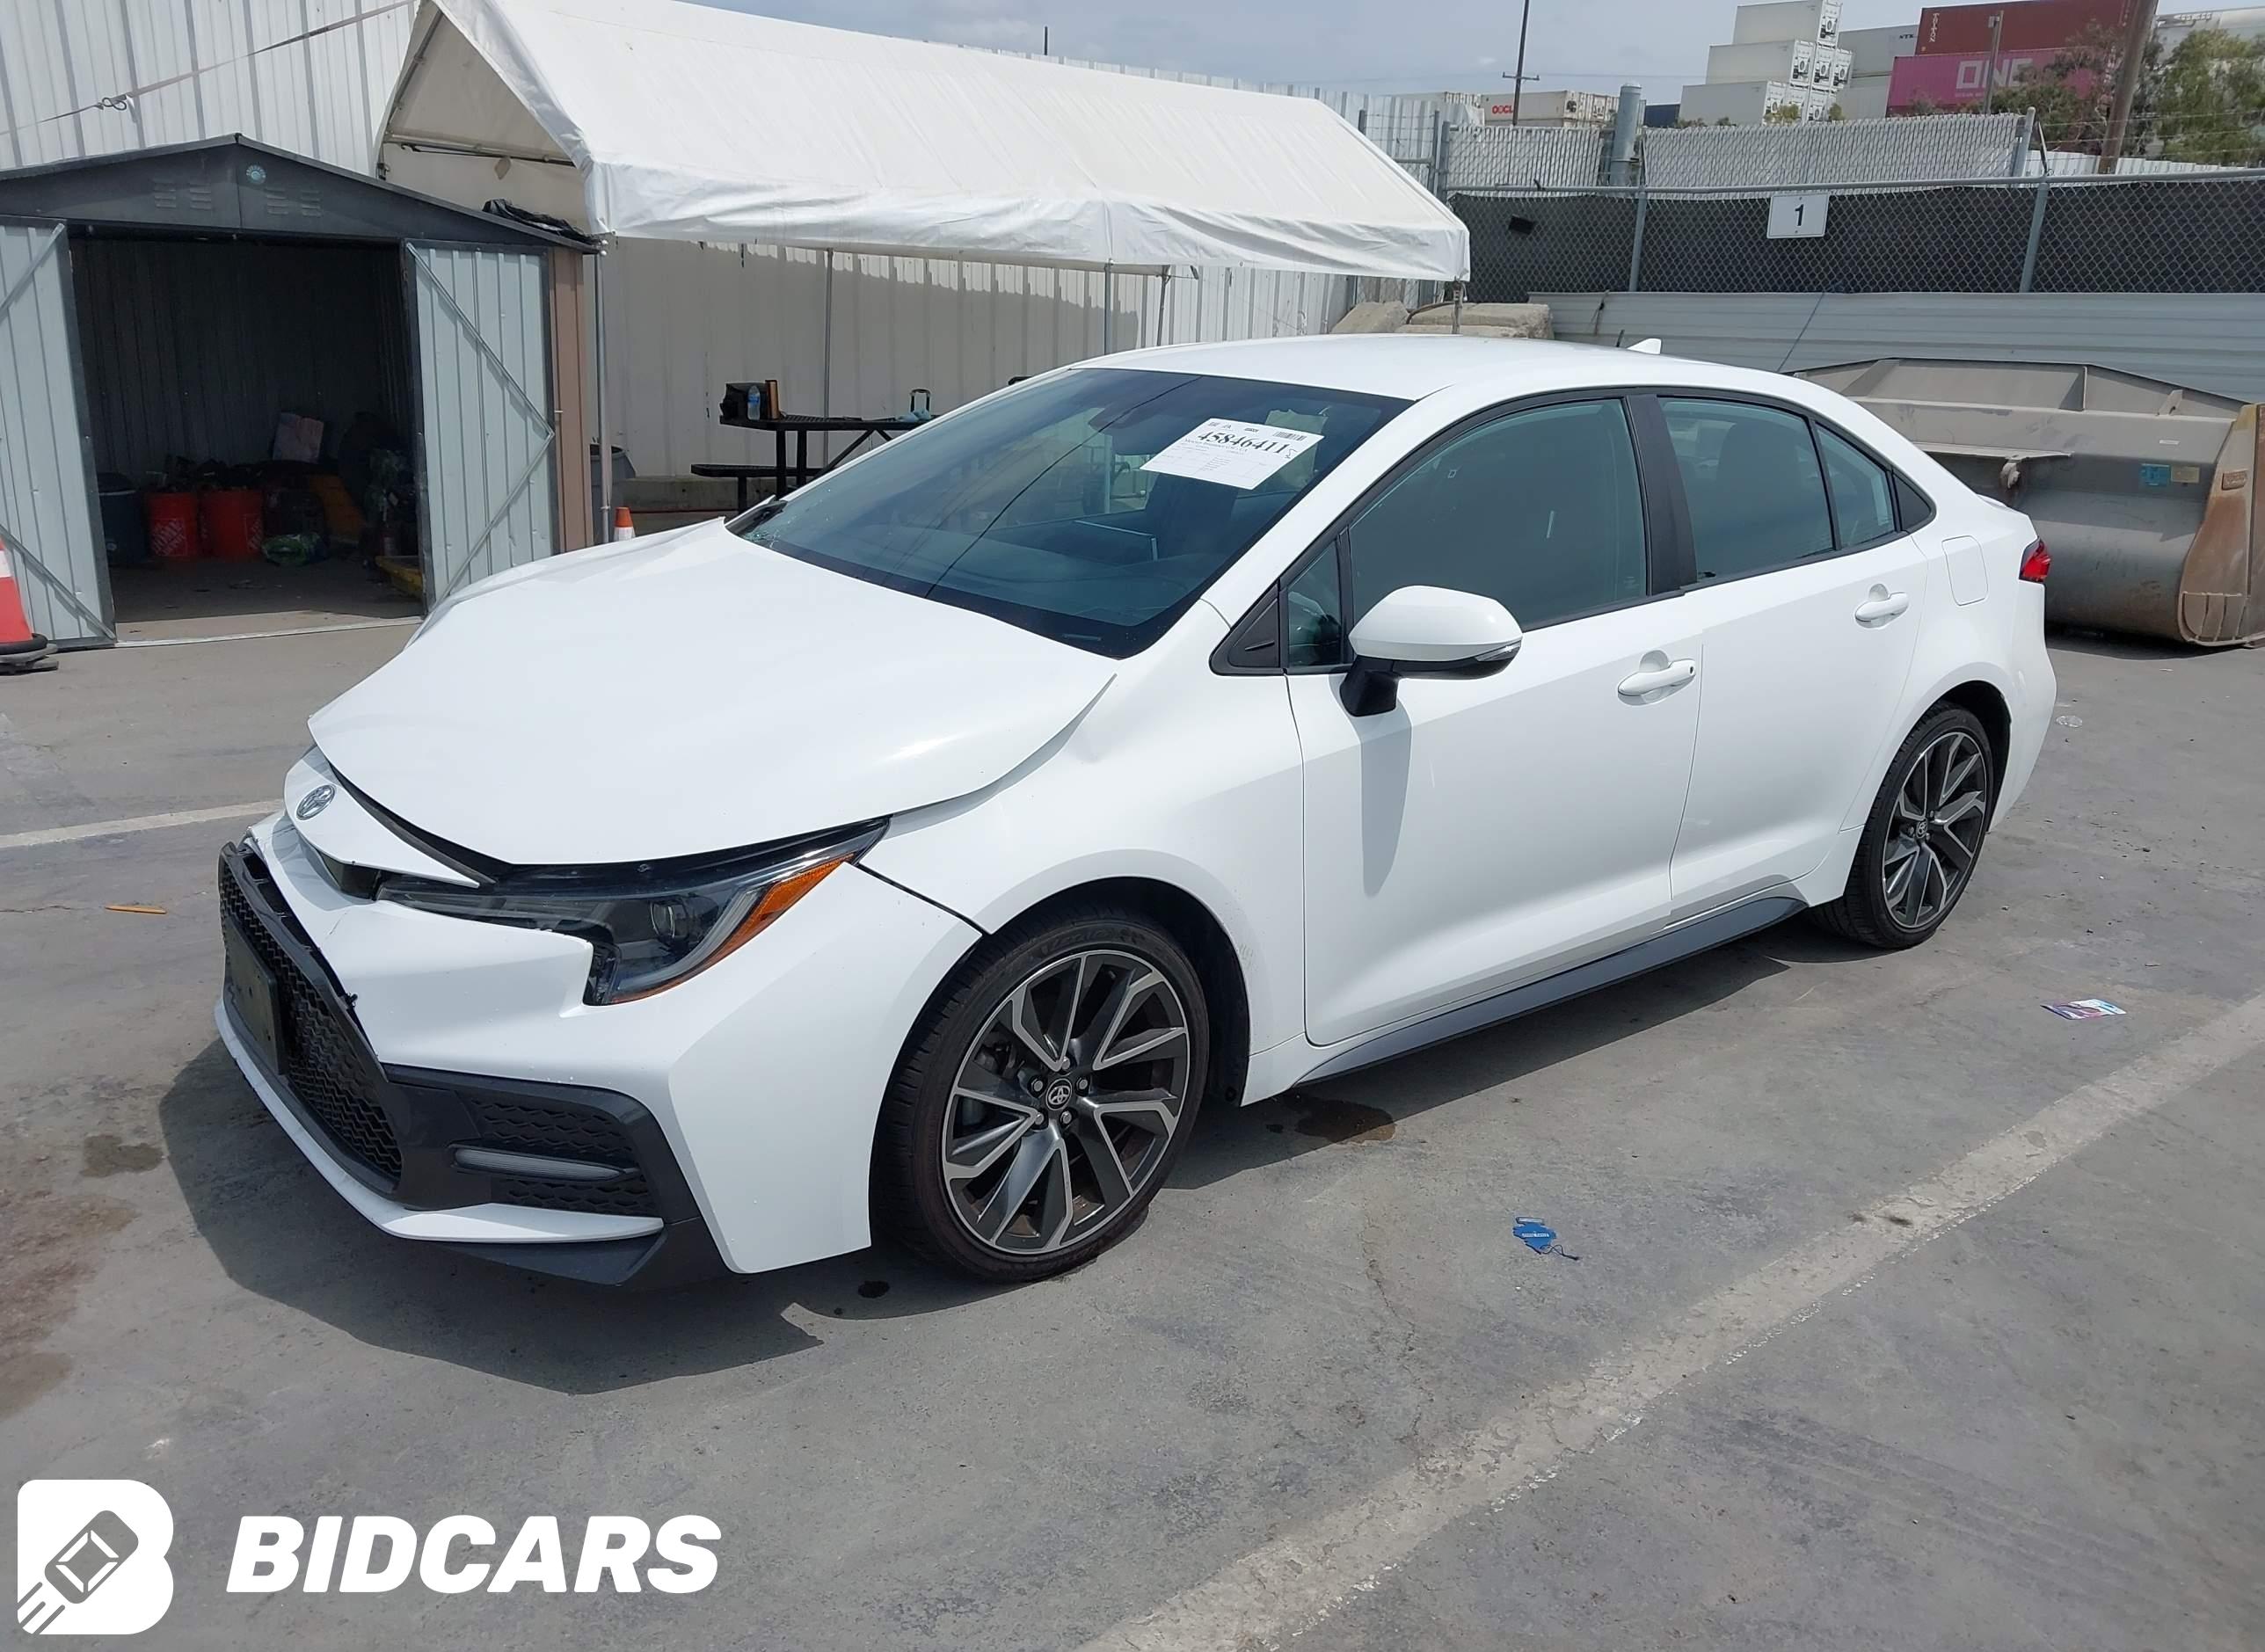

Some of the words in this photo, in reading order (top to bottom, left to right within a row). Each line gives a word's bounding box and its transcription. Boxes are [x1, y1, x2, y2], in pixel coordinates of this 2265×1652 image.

[1956, 59, 2033, 89] ONE
[1795, 204, 1804, 227] 1
[1198, 432, 1290, 453] 45846411
